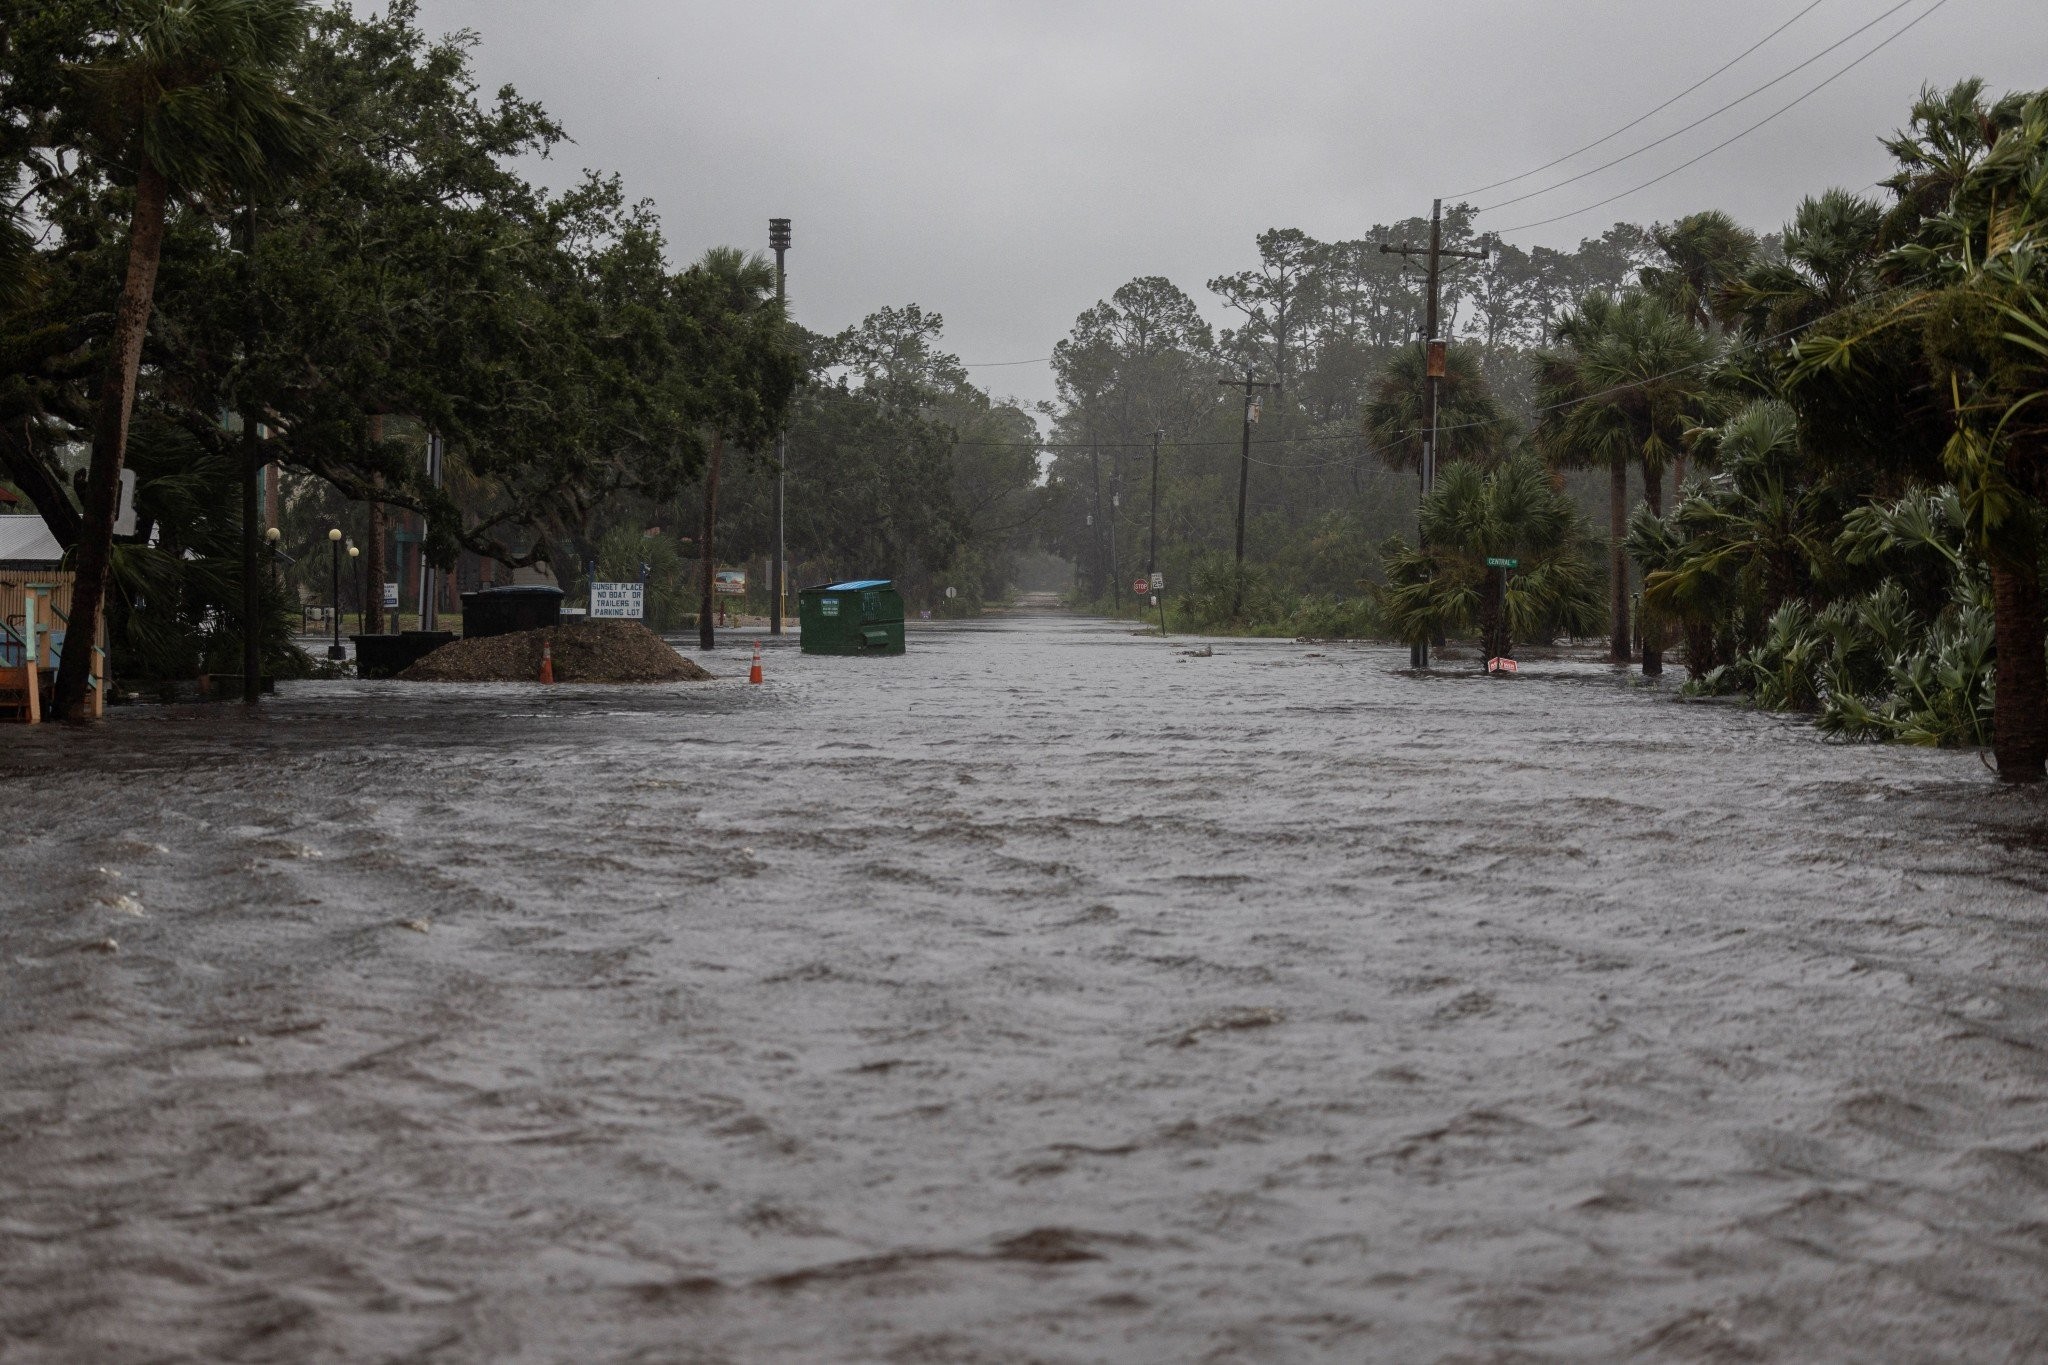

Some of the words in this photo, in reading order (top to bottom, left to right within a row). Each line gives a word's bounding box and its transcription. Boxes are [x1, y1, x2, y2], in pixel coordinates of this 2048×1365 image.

[1488, 558, 1510, 566] CENTRAL
[609, 591, 627, 599] BOAT
[632, 591, 641, 599] OR
[595, 608, 624, 616] PARKING
